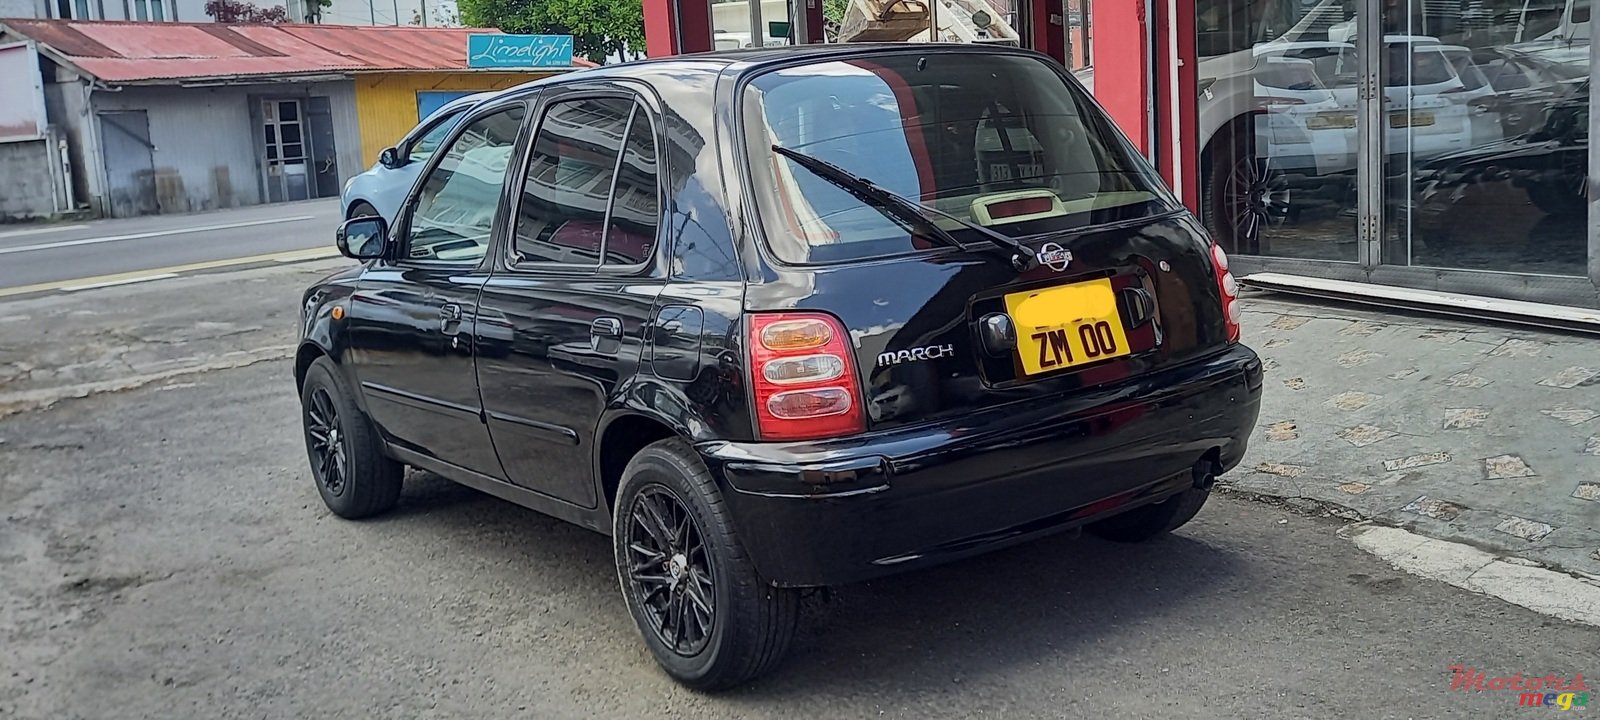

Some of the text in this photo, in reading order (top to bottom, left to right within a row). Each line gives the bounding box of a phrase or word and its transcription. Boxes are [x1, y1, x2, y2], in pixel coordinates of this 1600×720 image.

[472, 36, 571, 66] Limelight
[877, 343, 954, 366] MARCH
[1031, 329, 1074, 368] ZM
